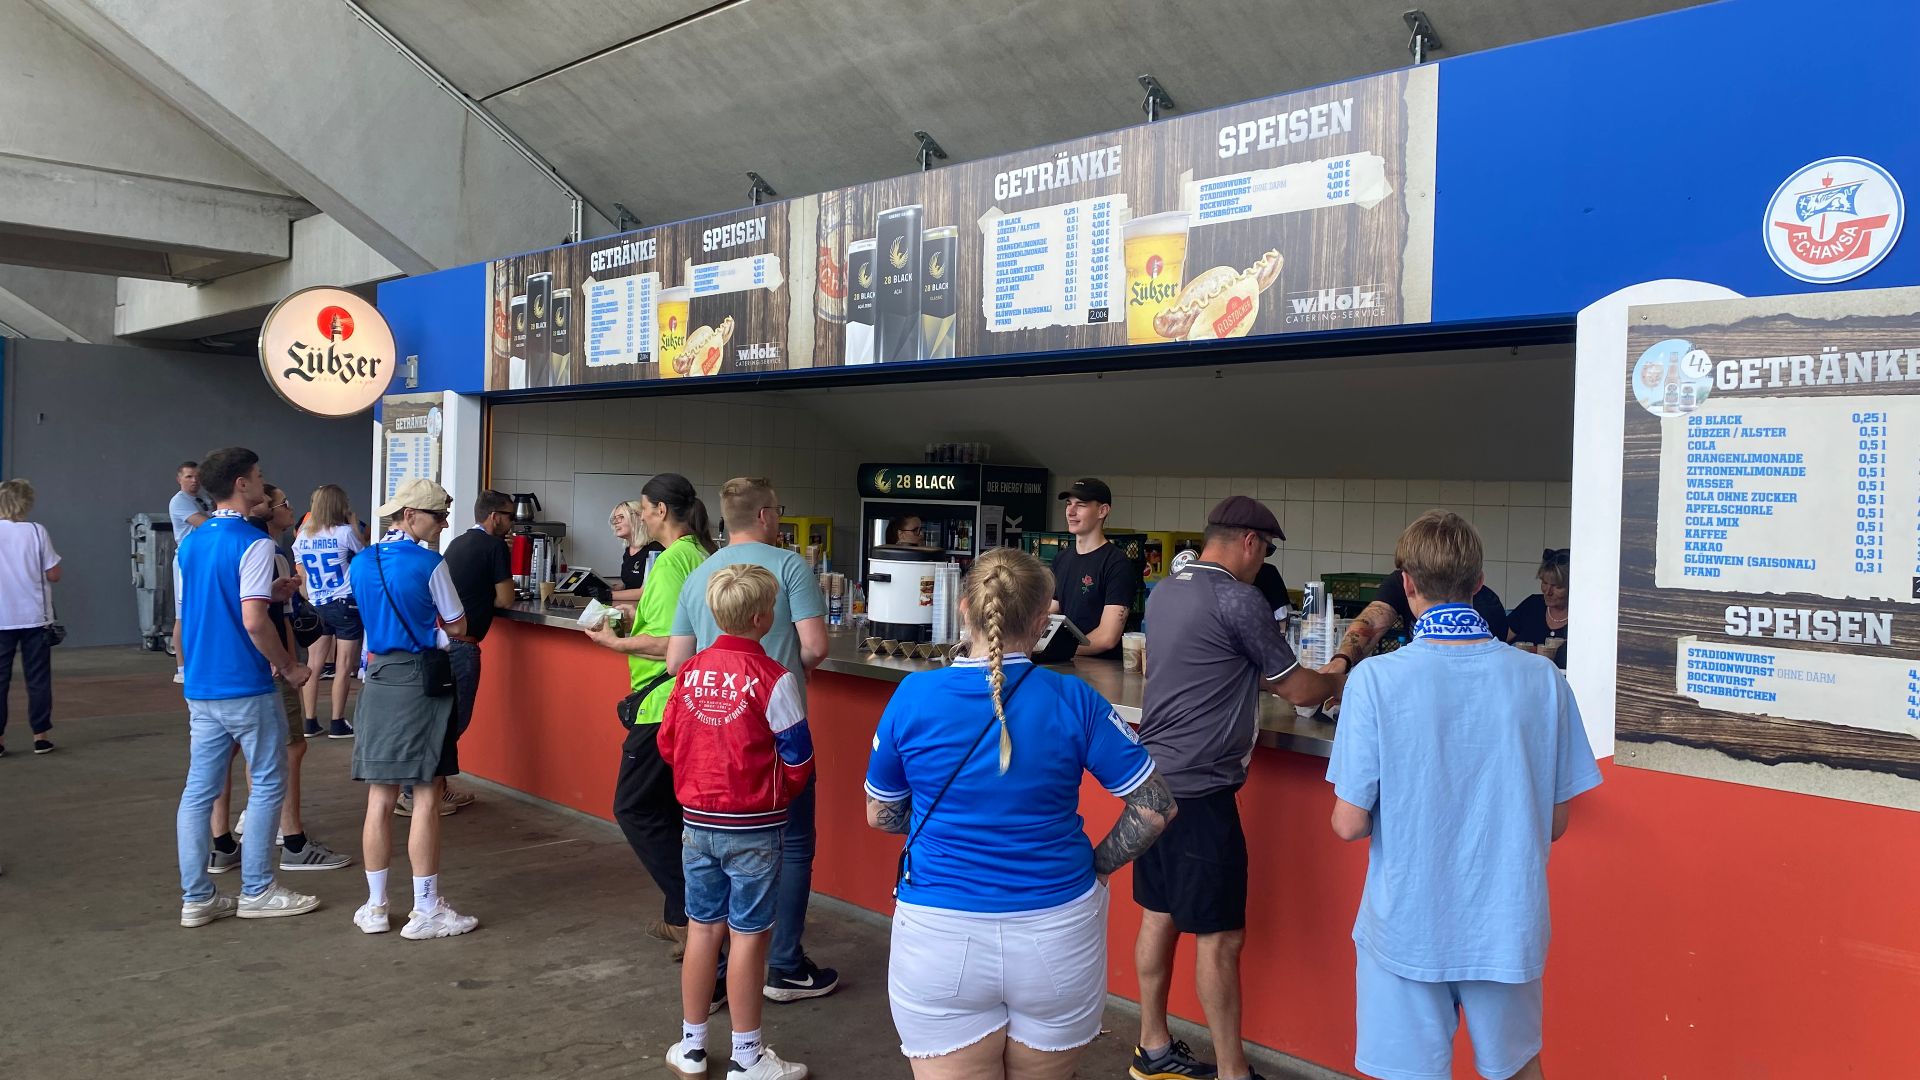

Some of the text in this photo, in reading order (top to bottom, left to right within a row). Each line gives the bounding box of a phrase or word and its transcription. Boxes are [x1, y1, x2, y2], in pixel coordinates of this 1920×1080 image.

[1218, 98, 1353, 158] SPEISEN
[994, 144, 1122, 200] GETRÄNKE
[1200, 177, 1251, 192] STADIONWURST
[1327, 161, 1343, 170] 4,00
[1200, 187, 1251, 201] STADIONWURST
[1327, 171, 1343, 180] 4,00
[1200, 197, 1239, 210] BOCKWURST
[1327, 181, 1343, 190] 4,00
[1327, 191, 1342, 200] 4,00
[703, 216, 766, 252] SPEISEN
[590, 238, 656, 272] GETRÄNKE
[893, 273, 913, 284] BLACK
[932, 282, 949, 291] BLACK
[1130, 281, 1178, 306] Lübzer
[284, 341, 381, 384] Lübzer
[1716, 346, 1920, 390] GETRÄNKE
[1689, 416, 1702, 425] 28
[1705, 415, 1742, 425] BLACK
[1852, 413, 1879, 423] 0,25
[1688, 427, 1730, 438] LÜBZER
[1733, 427, 1738, 438] /
[1741, 427, 1786, 437] ALSTER
[1860, 426, 1878, 437] 0,5
[1688, 441, 1716, 450] COLA
[1859, 440, 1878, 451] 0,5
[1687, 453, 1803, 463] ORANGENLIMONADE
[1859, 454, 1878, 464] 0,5
[1687, 466, 1806, 476] ZITRONENLIMONADE
[1858, 468, 1877, 478] 0,5
[896, 474, 955, 490] 28 BLACK
[987, 481, 1041, 494] DER ENERGY DRINK
[1687, 479, 1733, 488] WASSER
[1858, 481, 1876, 492] 0,5
[1686, 491, 1714, 501] COLA
[1717, 492, 1748, 501] OHNE
[1751, 492, 1797, 503] ZUCKER
[1858, 494, 1876, 505] 0,5
[1686, 504, 1773, 515] APFELSCHORLE
[1857, 508, 1876, 519] 0,5
[1685, 516, 1713, 526] COLA
[1716, 517, 1739, 527] MIX
[1857, 522, 1876, 533] 0,5
[312, 538, 338, 549] HANSA
[1685, 529, 1727, 539] KAFFEE
[1856, 536, 1876, 546] 0,3
[1684, 542, 1722, 552] KAKAO
[1856, 549, 1874, 560] 0,3
[302, 552, 344, 589] 65
[1684, 553, 1744, 566] GLÜHWEIN
[1747, 556, 1816, 570] (SAISONAL)
[1856, 562, 1874, 573] 0,3
[1684, 567, 1720, 577] PFAND
[1725, 605, 1893, 645] SPEISEN
[1688, 648, 1775, 664] STADIONWURST
[1687, 672, 1755, 687] BOCKWURST
[1688, 660, 1836, 685] STADIONWURST OHNE DARM
[694, 687, 738, 701] BIKER
[1686, 683, 1776, 702] FISCHBRÖTCHEN
[735, 1042, 760, 1050] LOTTO
